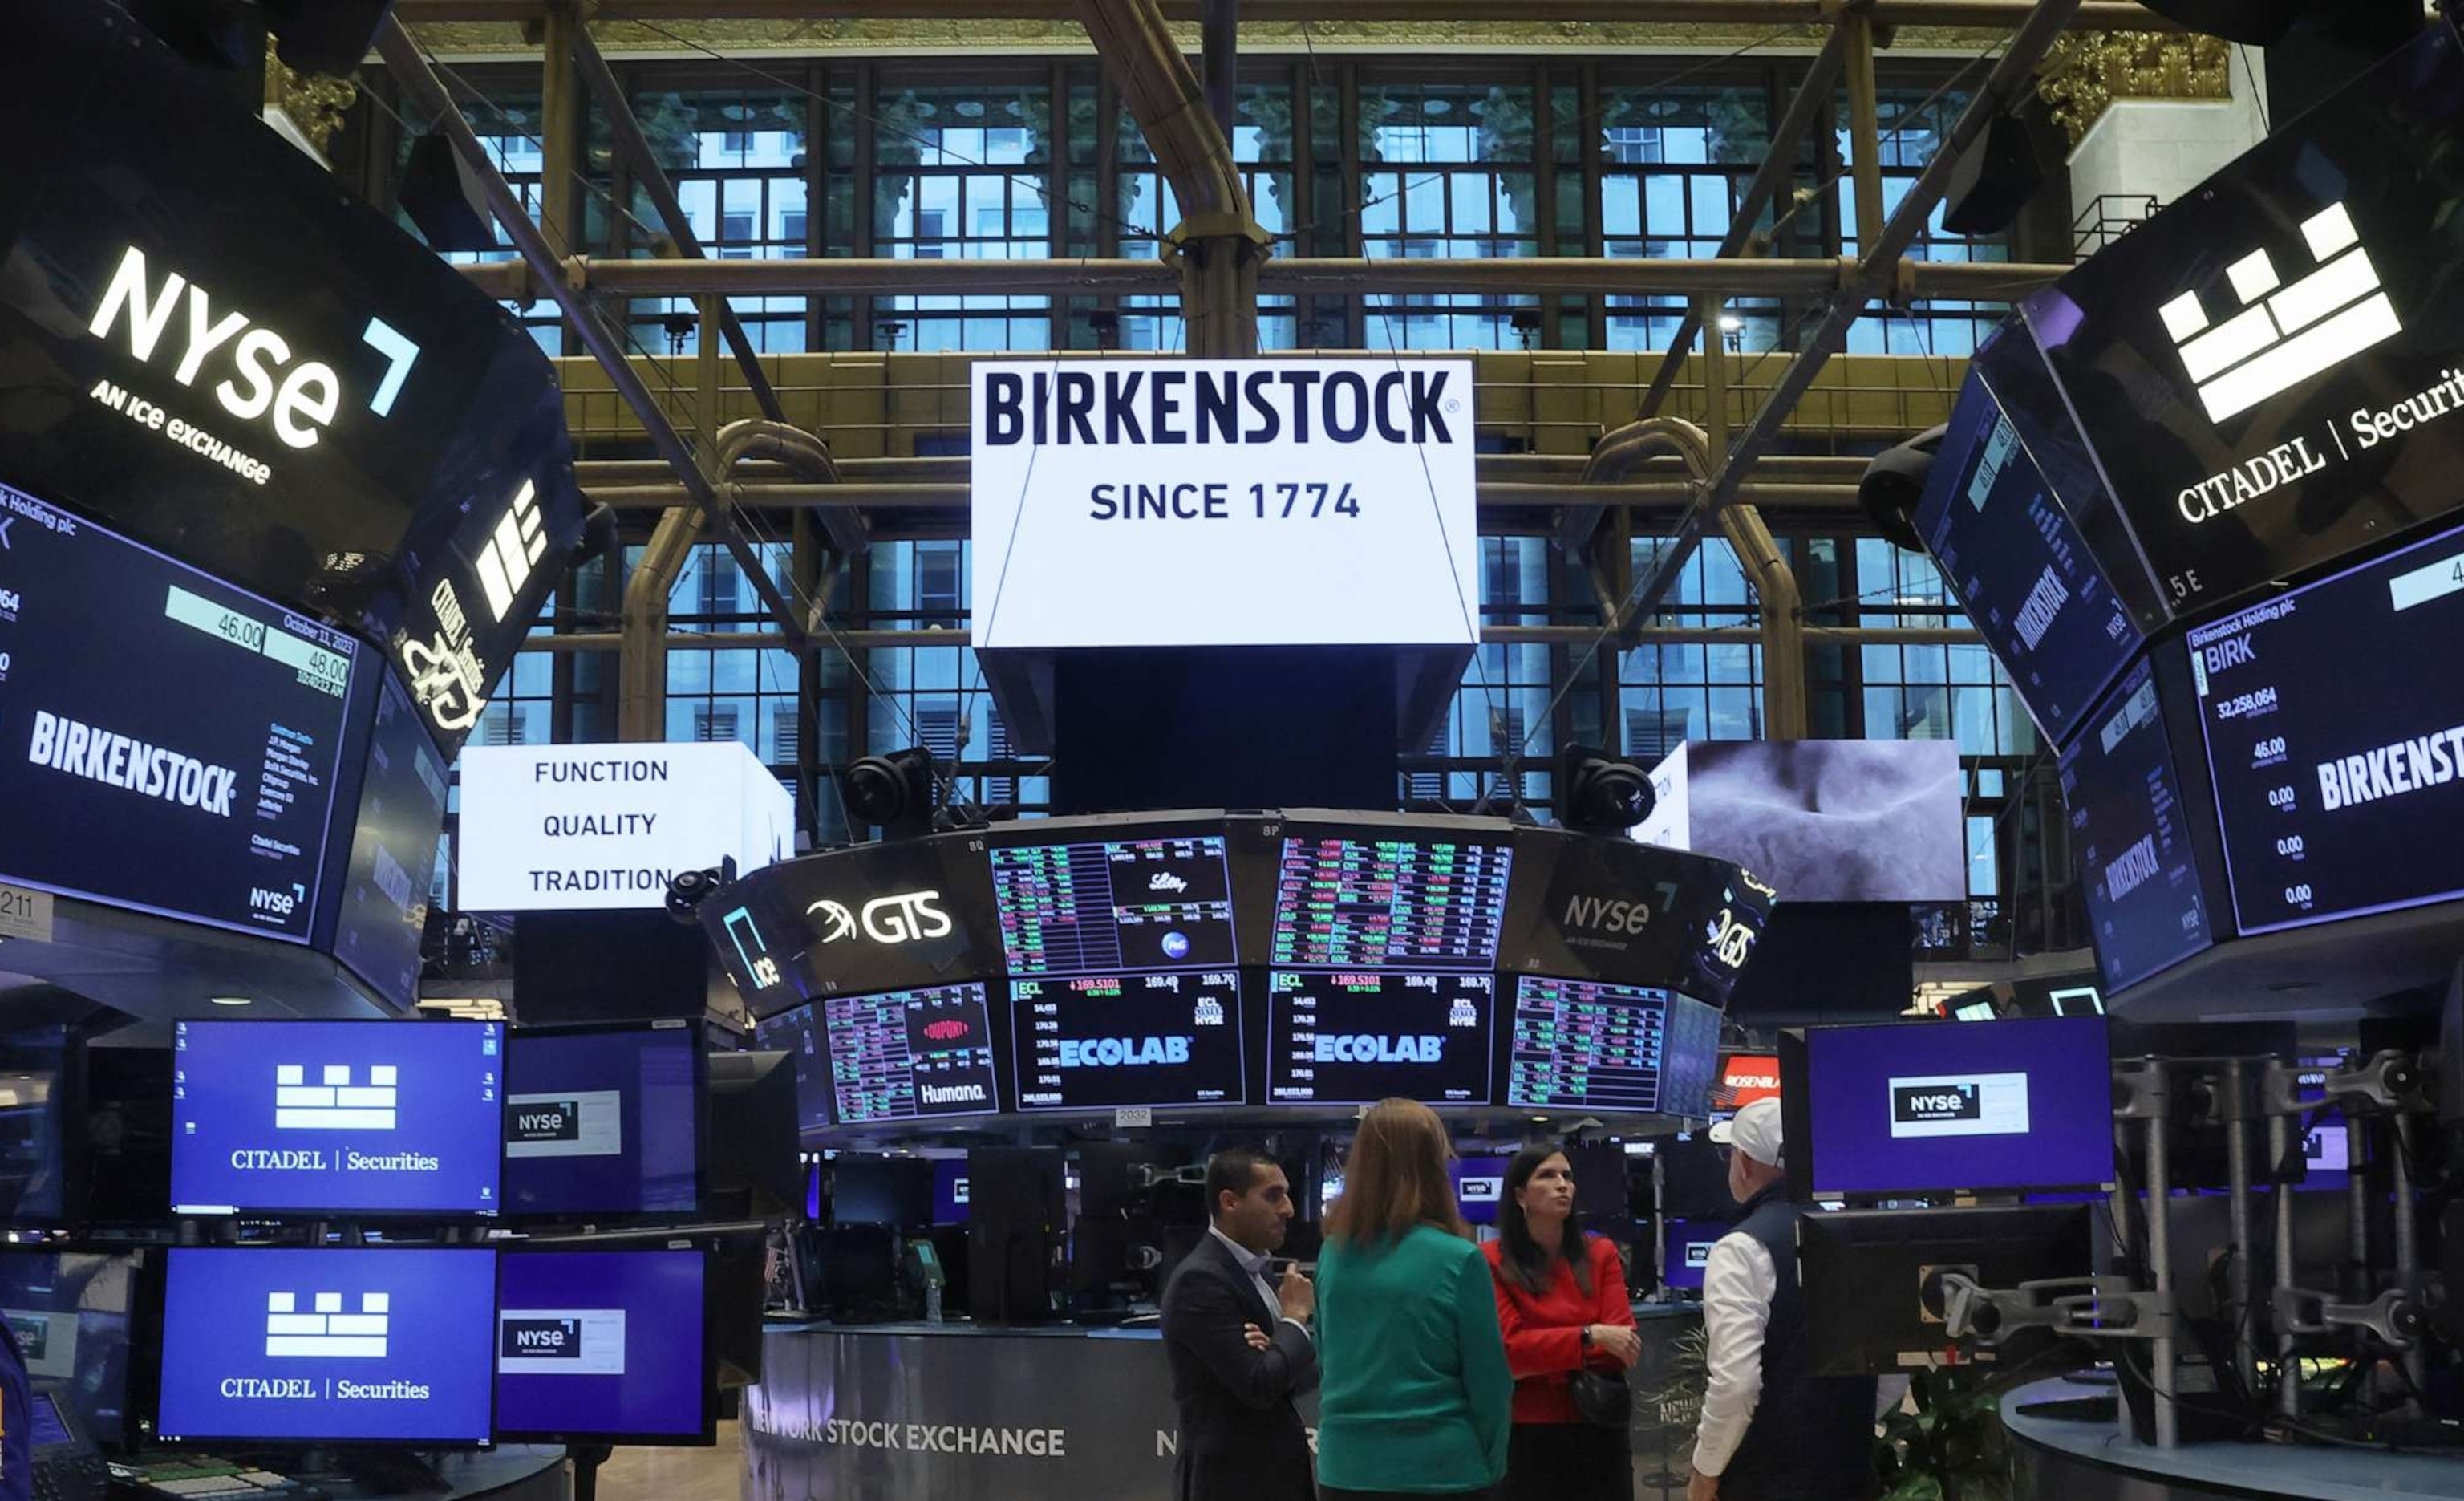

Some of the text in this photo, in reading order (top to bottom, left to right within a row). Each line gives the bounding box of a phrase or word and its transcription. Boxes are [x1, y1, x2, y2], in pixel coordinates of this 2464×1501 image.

[91, 379, 125, 412] AN
[985, 371, 1453, 446] BIRKENSTOCK
[2178, 436, 2327, 524] CITADEL
[10, 494, 57, 529] Holding
[1091, 482, 1360, 520] SINCE 1774
[218, 614, 262, 648] 46.00
[283, 614, 318, 640] October
[331, 635, 354, 654] 2023
[2191, 598, 2296, 647] Birkenstock Holding plc
[308, 651, 348, 683] 48.00
[2206, 632, 2256, 675] BIRK
[2216, 686, 2278, 720] 32,258,064
[2254, 736, 2286, 759] 46.00
[29, 710, 236, 818] BIRKENSTOCK
[535, 761, 669, 783] FUNCTION
[2268, 785, 2295, 807] 0.00
[544, 813, 657, 838] QUALITY
[2277, 834, 2304, 856] 0.00
[529, 868, 674, 892] TRADITION
[2285, 883, 2312, 905] 0.00
[861, 890, 953, 944] GTS
[1019, 982, 1044, 995] ECL
[1076, 978, 1121, 991] 169.5101
[1145, 976, 1179, 988] 169.49
[1279, 973, 1304, 987] ECL
[1338, 975, 1381, 986] 169.5101
[1404, 976, 1437, 988] 169.49
[1059, 1036, 1190, 1067] ECOLAB
[1315, 1034, 1442, 1063] ECOLAB
[231, 1150, 440, 1172] CITADEL Securities
[220, 1378, 430, 1400] CITADEL Securities
[827, 1418, 900, 1450] STOCK
[906, 1424, 1065, 1456] EXCHANGE
